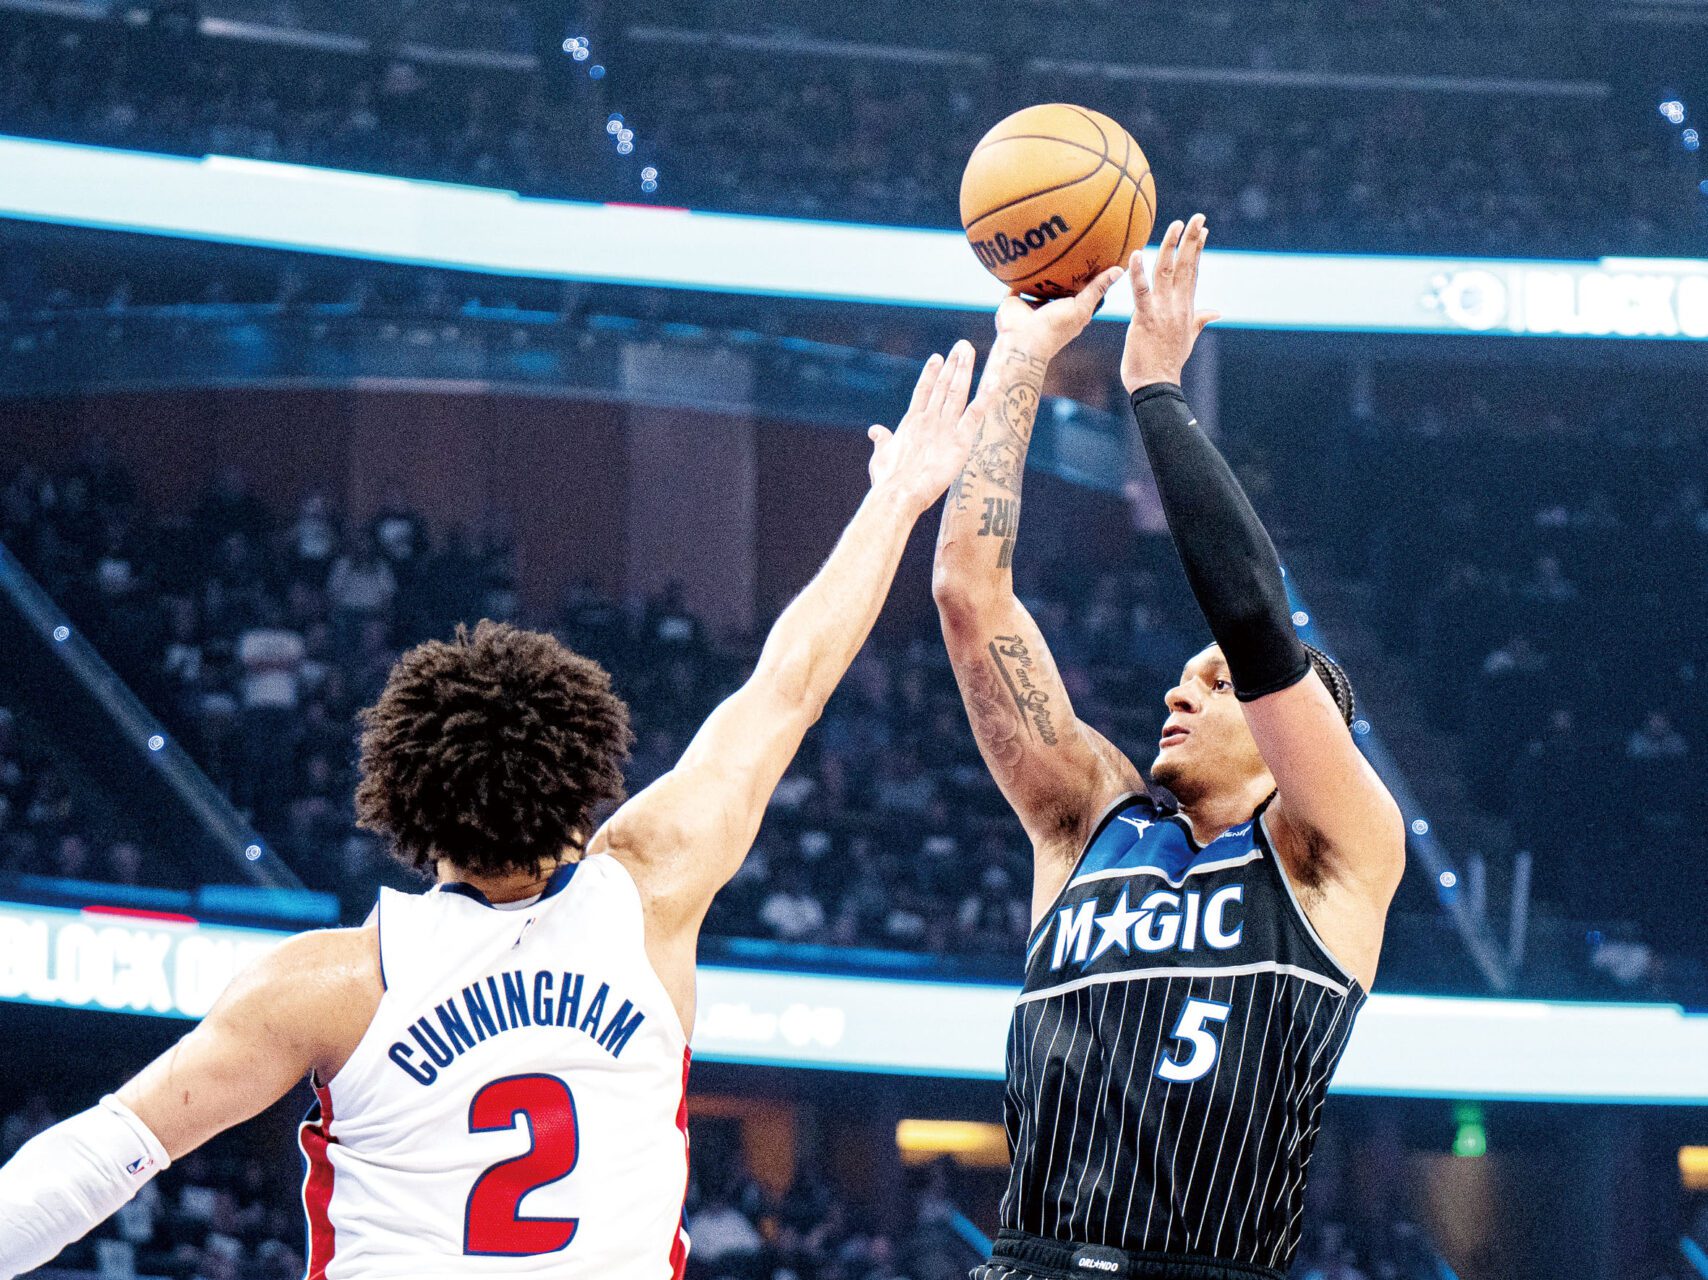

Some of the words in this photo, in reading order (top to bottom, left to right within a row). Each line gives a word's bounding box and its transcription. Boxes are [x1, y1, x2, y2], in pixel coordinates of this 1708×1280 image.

[972, 214, 1070, 269] Wilson
[1050, 881, 1244, 972] MAGIC
[388, 970, 645, 1086] CUNNINGHAM
[1154, 996, 1233, 1083] 5
[463, 1073, 579, 1257] 2
[1079, 1257, 1119, 1272] ORLANDO
